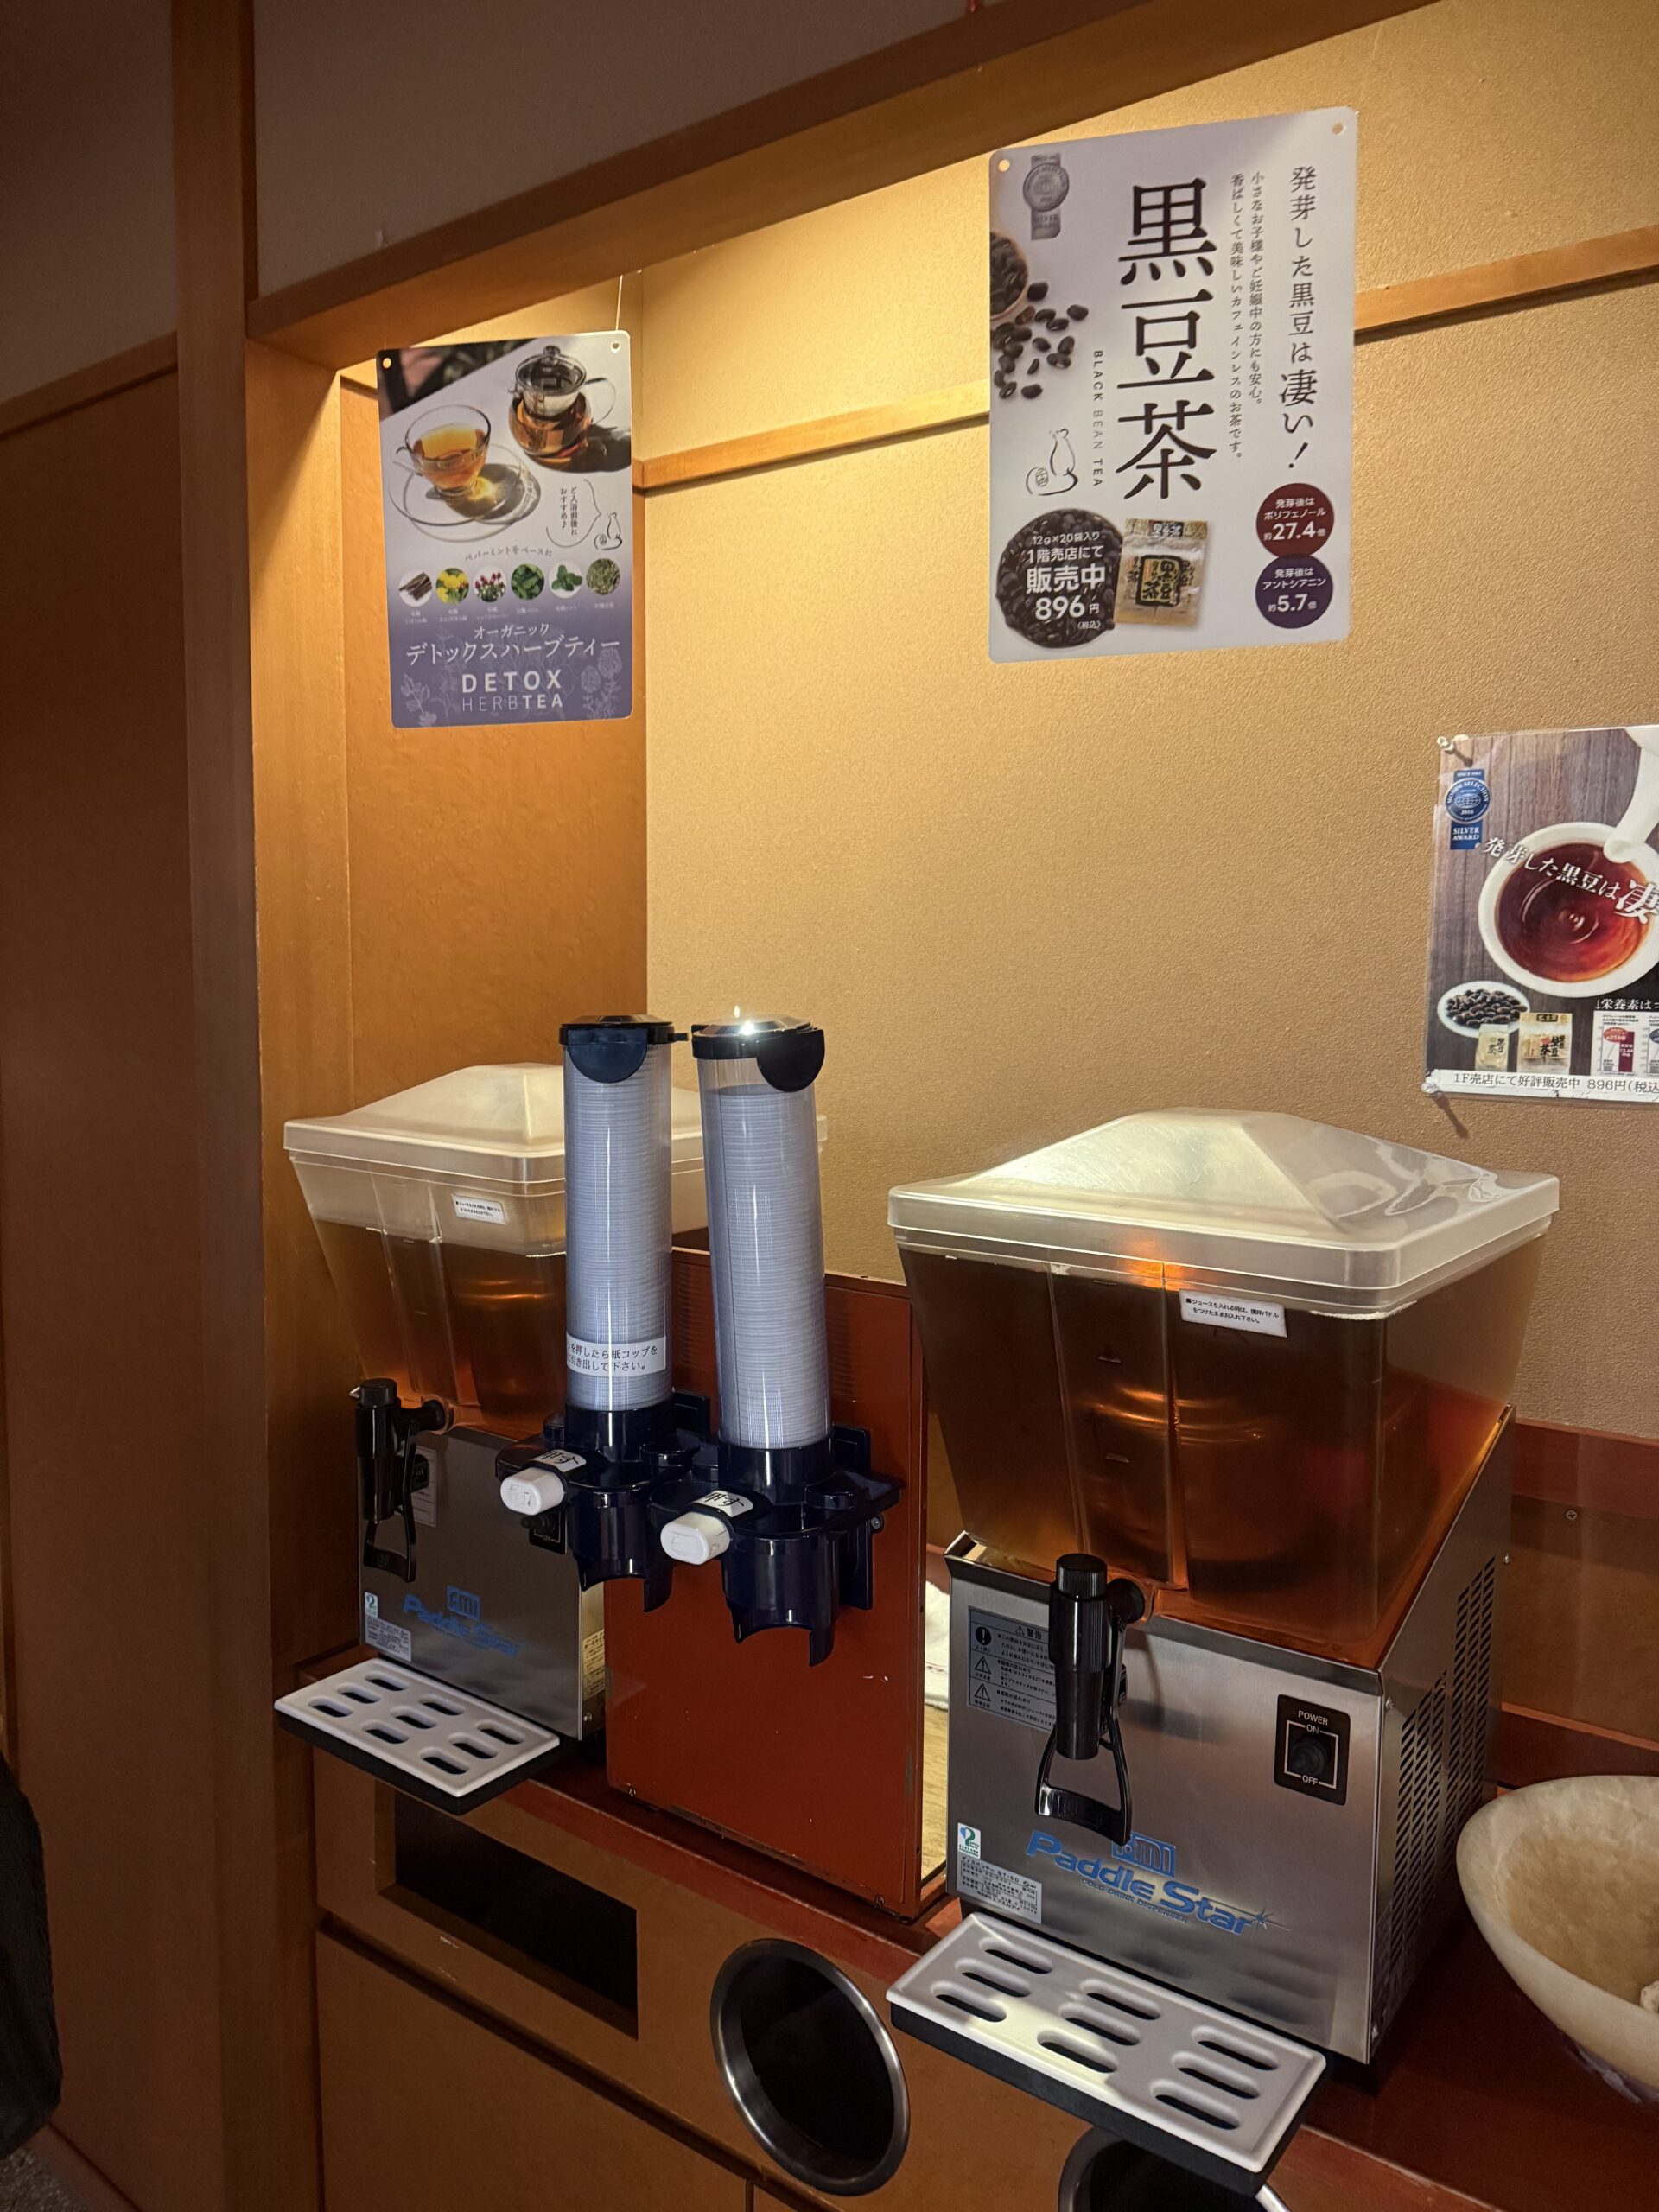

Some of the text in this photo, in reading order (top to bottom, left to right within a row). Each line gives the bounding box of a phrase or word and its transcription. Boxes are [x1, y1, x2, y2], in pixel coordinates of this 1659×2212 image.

[1116, 176, 1217, 500] 黒豆茶
[1093, 350, 1103, 487] BLACK BEAN TEA
[1275, 497, 1315, 509] 発芽後は
[1263, 508, 1327, 520] ポリフェノール
[1027, 545, 1104, 563] 1階売店にて
[1026, 563, 1105, 594] 販売中
[1274, 568, 1314, 579] 発芽後は
[1262, 578, 1326, 591] アントシアニン
[474, 622, 550, 640] オーガニック
[406, 634, 620, 665] デトックスハーブティー
[461, 669, 563, 694] DETOX
[1453, 1071, 1580, 1090] 1F売店にて好評販売中
[568, 1343, 658, 1359] を押したら紙コップを
[568, 1354, 645, 1372] 引き出して下さい。
[1298, 1710, 1328, 1726] POWER
[1306, 1724, 1319, 1734] ON
[1302, 1775, 1319, 1785] OFF
[1026, 1830, 1252, 1936] Paddle Star
